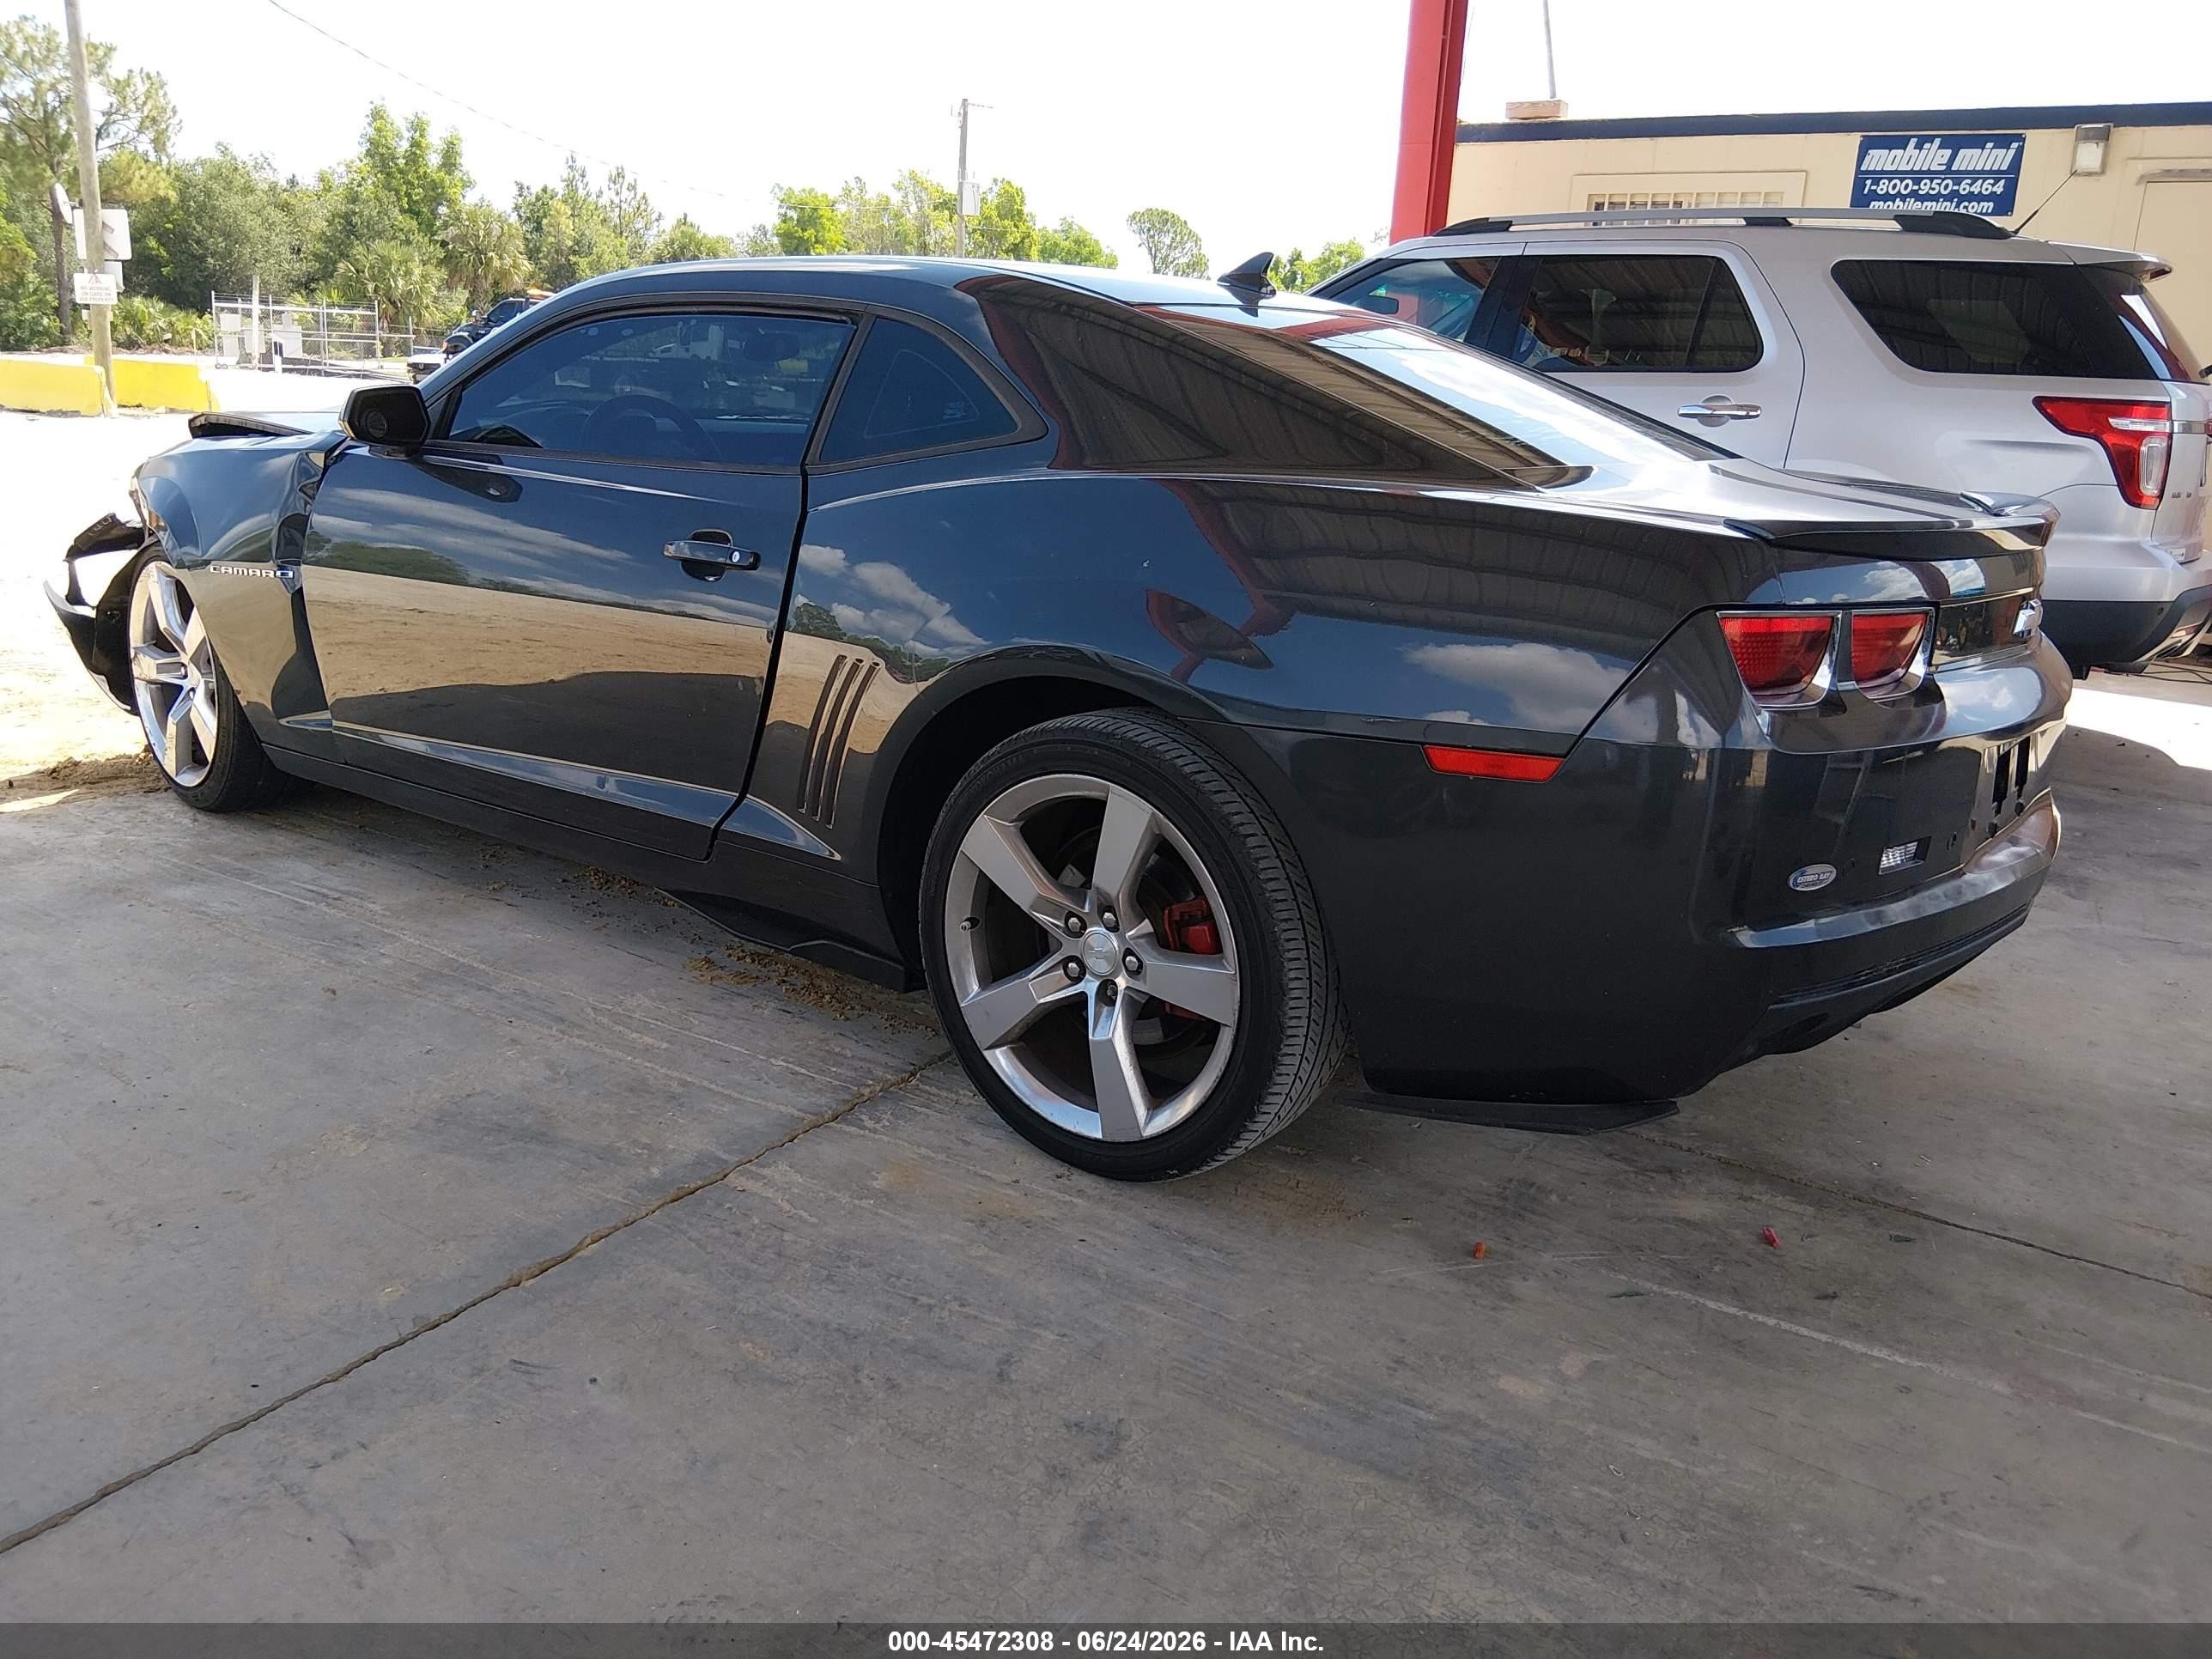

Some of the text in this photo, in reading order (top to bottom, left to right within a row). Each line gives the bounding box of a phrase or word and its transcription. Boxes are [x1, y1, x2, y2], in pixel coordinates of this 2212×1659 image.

[1861, 137, 2020, 171] mobile mini
[1863, 179, 2006, 195] 1-800-950-6464
[1869, 198, 1994, 213] mobilemini.com
[210, 565, 294, 579] CAMARO
